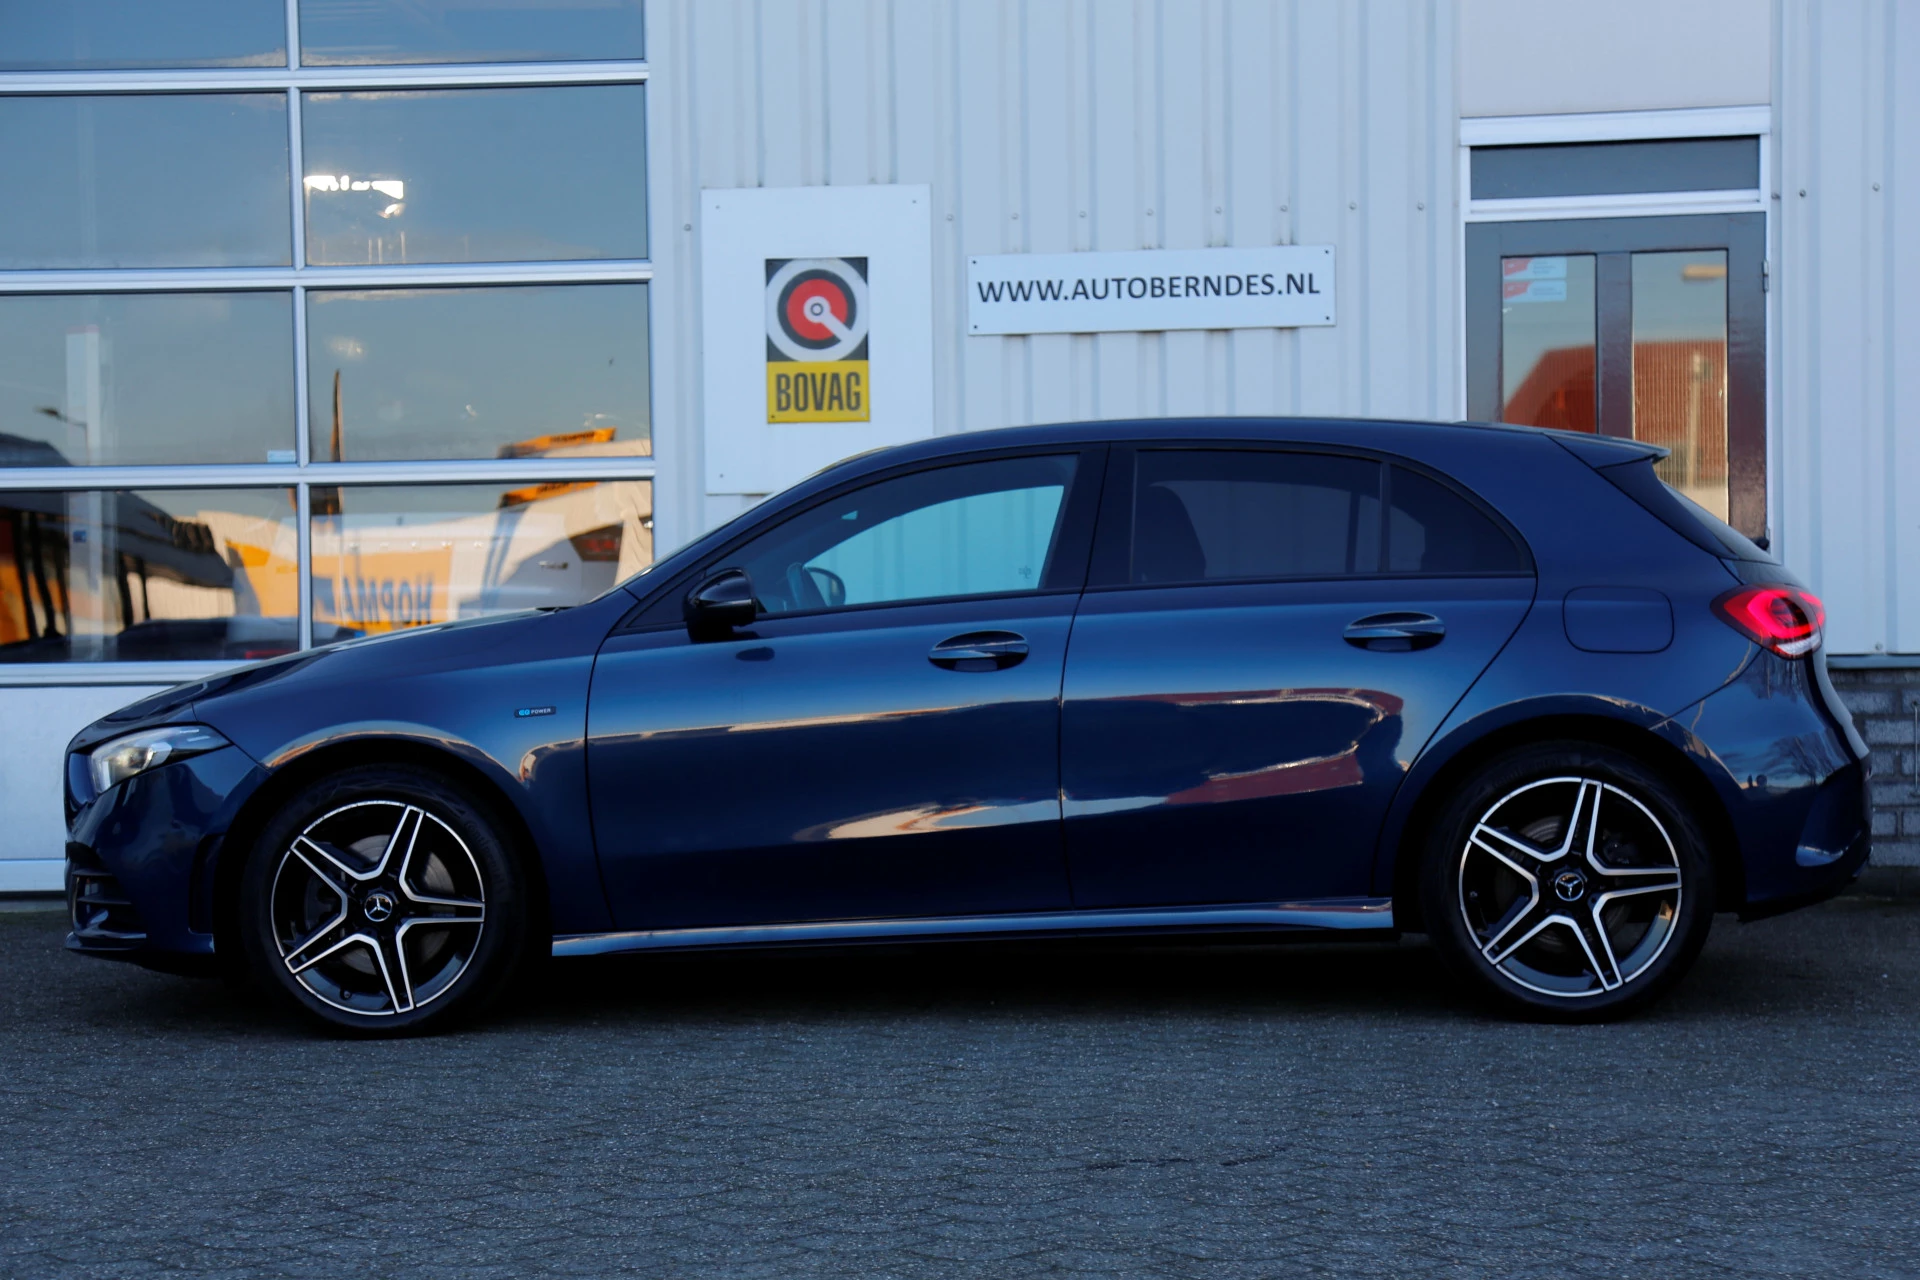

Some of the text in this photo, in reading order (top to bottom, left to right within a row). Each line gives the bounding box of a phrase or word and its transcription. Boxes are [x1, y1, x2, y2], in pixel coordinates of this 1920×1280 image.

[977, 272, 1321, 303] WWW.AUTOBERNDES.NL
[776, 371, 861, 412] BOVAG
[531, 707, 551, 715] POWER
